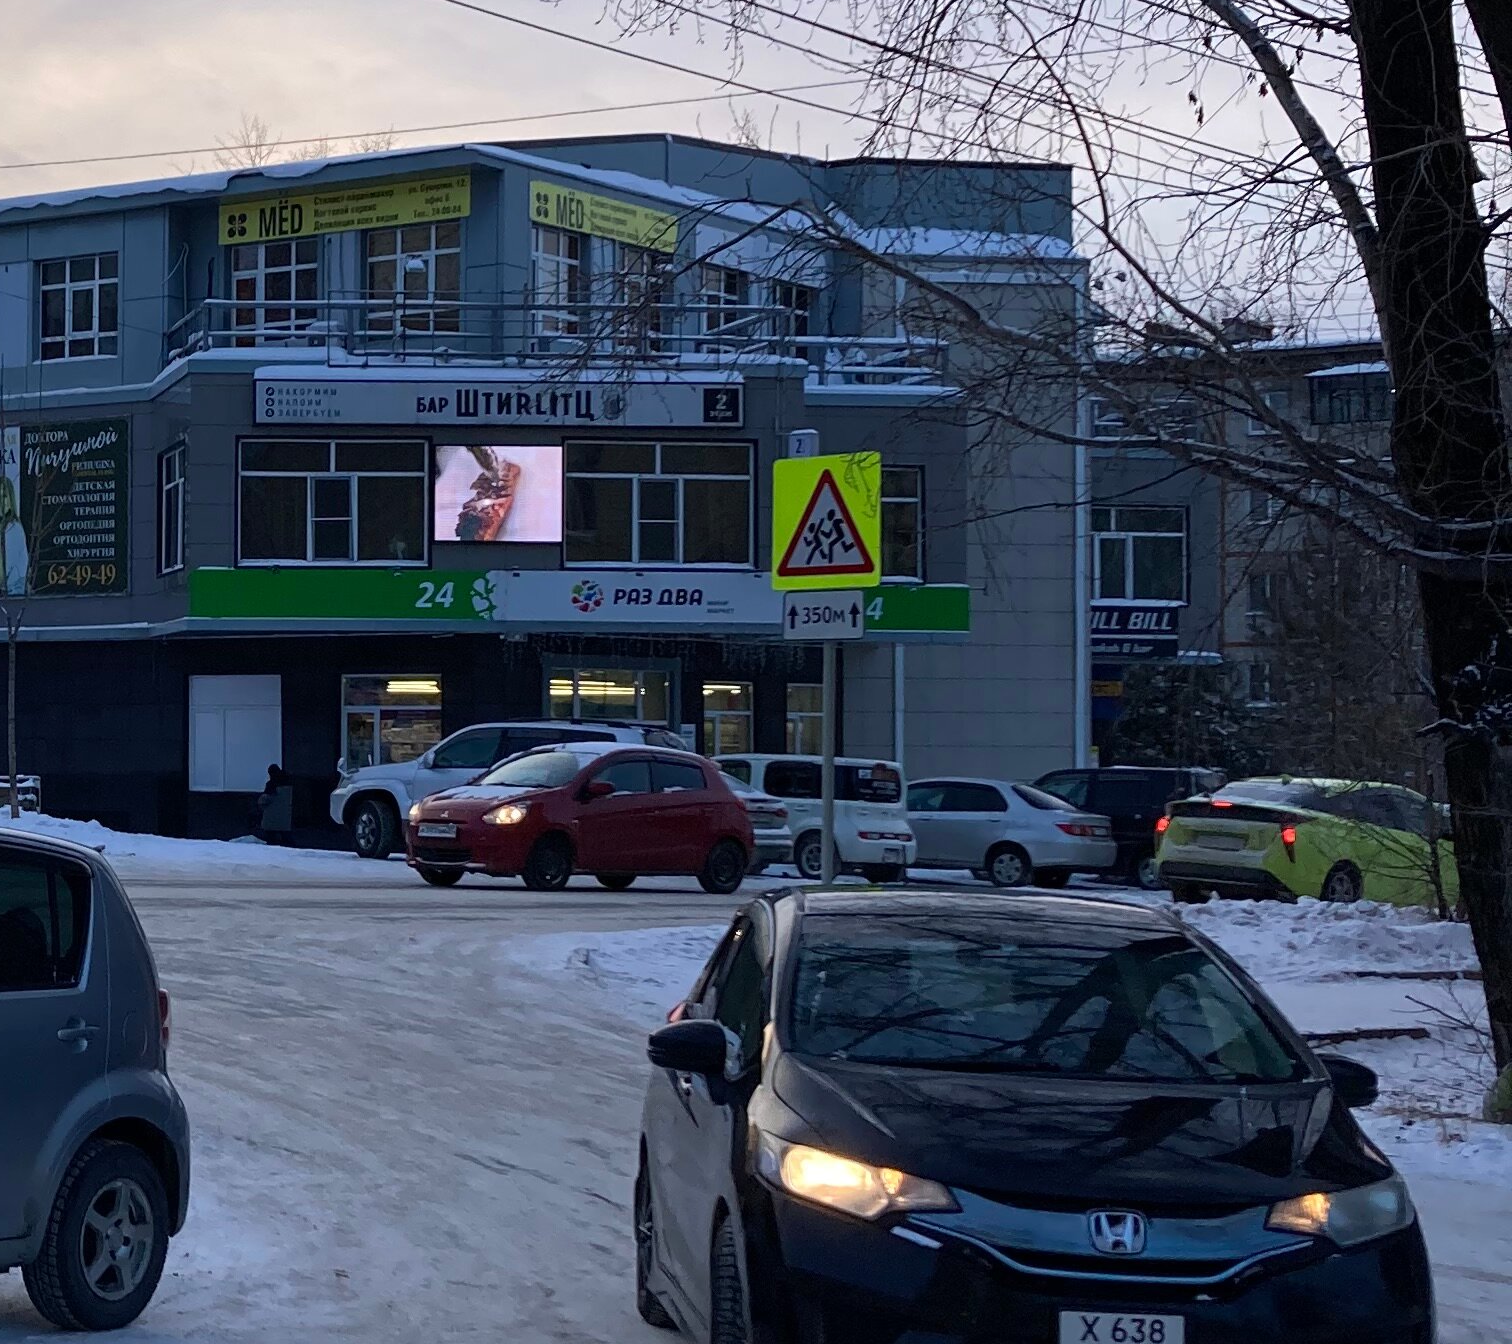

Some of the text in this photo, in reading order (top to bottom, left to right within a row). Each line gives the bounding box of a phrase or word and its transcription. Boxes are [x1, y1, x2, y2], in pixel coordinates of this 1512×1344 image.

[416, 396, 449, 413] БАР
[715, 394, 728, 410] 2
[71, 480, 116, 492] ДЕТСКАЯ
[41, 492, 116, 505] СТОМАТОЛОГИЯ
[74, 505, 116, 516] ТЕРАПИЯ
[59, 519, 116, 531] ОРТОПЕДИЯ
[52, 533, 116, 545] ОРТОДОНТИЯ
[67, 547, 116, 558] ХИРУРГИЯ
[48, 563, 117, 586] 62-49-49
[415, 581, 455, 608] 24
[613, 588, 704, 606] РАЗ ДВА
[866, 597, 884, 620] 4
[1090, 611, 1172, 630] ILL BILL
[1111, 1317, 1166, 1344] 638
